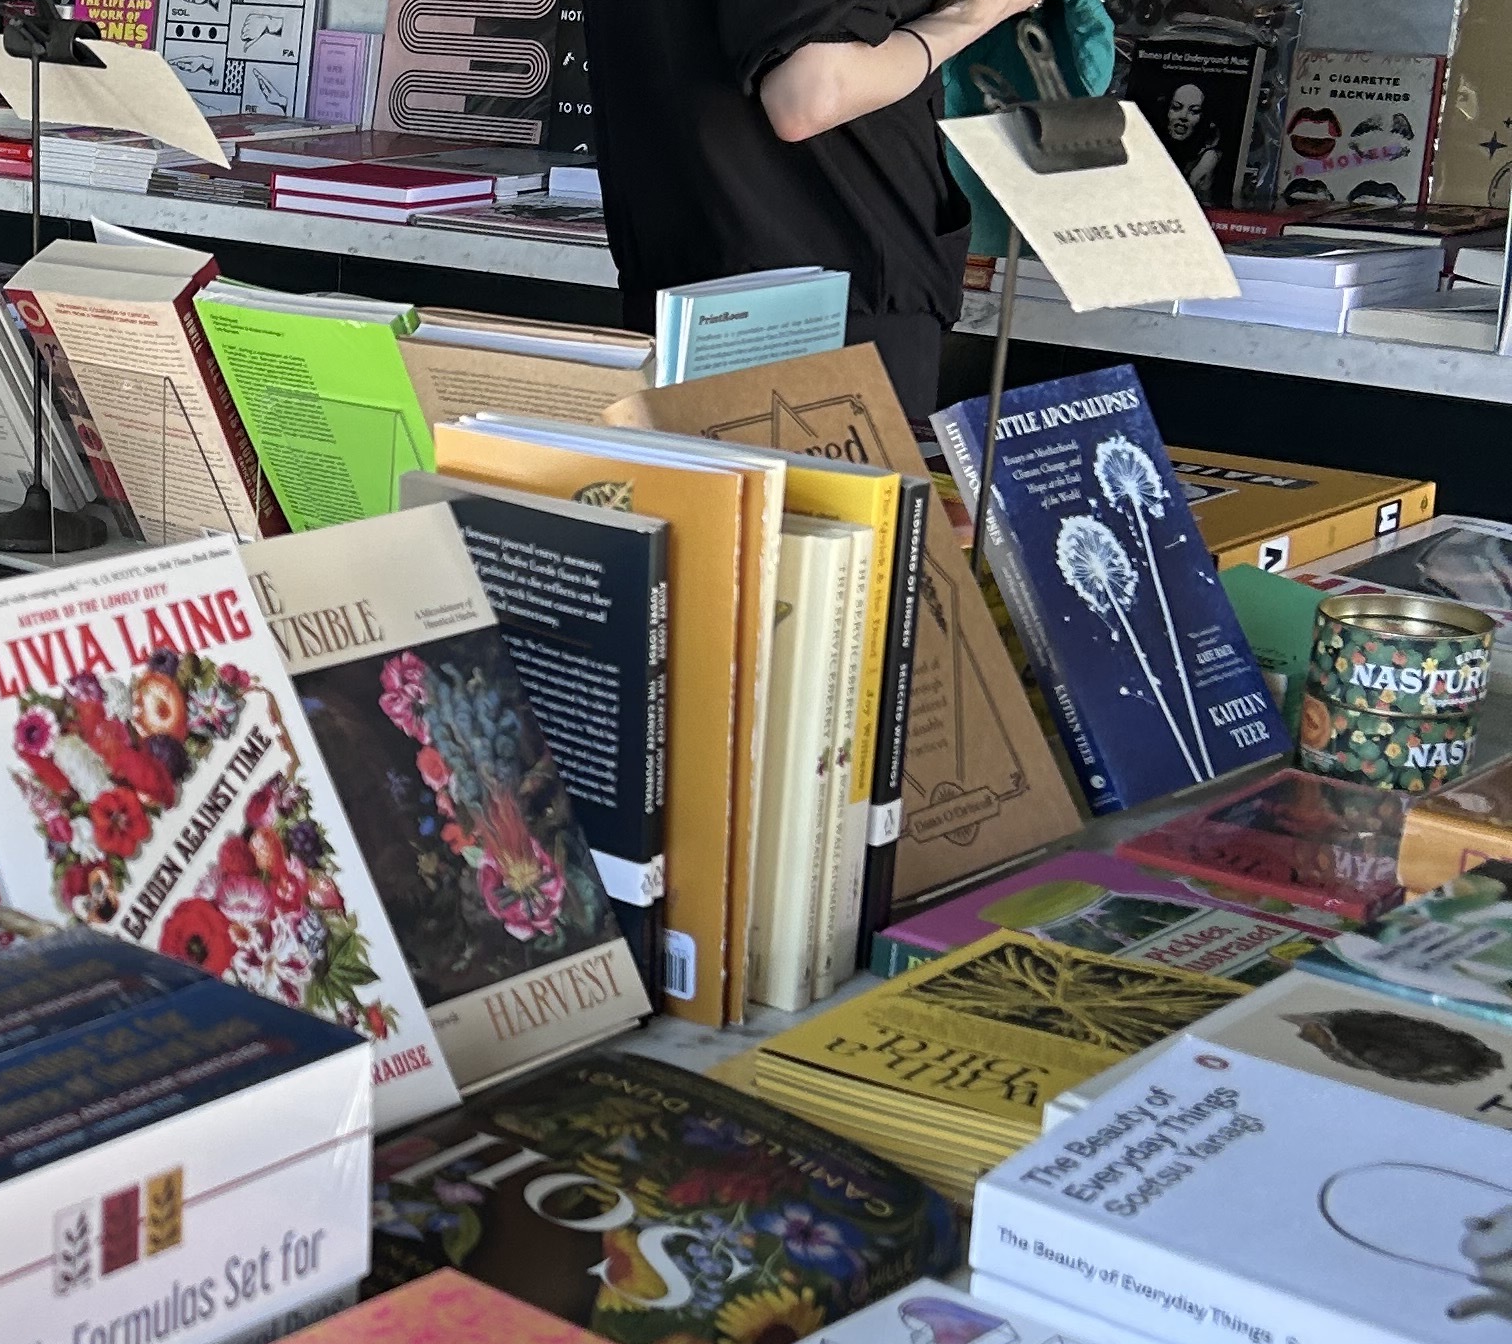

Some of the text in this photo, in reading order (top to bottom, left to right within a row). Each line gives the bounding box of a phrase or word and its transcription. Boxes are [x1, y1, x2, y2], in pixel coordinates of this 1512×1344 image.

[89, 8, 141, 24] WORK OF
[1300, 86, 1412, 103] LIT BACKWARDS
[1313, 73, 1402, 87] A CIGARETTE
[1053, 218, 1186, 246] NATURE & SCIENCE
[698, 308, 749, 327] PrintRoom
[17, 582, 169, 629] AUTHOR OF THE LONELY CITY
[115, 586, 255, 669] LAING
[889, 497, 924, 789] HILDEGARD OF BINGEN SELECTED WRITINGS
[1208, 692, 1269, 727] KAITLYN
[1229, 720, 1271, 749] TEER
[121, 723, 274, 942] GARDEN AGAINST TIME
[484, 950, 623, 1041] HARVEST
[1021, 1084, 1178, 1189] The Beauty of
[1063, 1084, 1241, 1204] Everyday Things
[1102, 1113, 1267, 1219] Soetsu Yanagi
[221, 1248, 273, 1312] Set
[276, 1224, 326, 1281] for
[997, 1225, 1031, 1254] The
[1033, 1239, 1098, 1286] Beauty
[1100, 1265, 1120, 1288] of
[1121, 1273, 1207, 1323] Everyday
